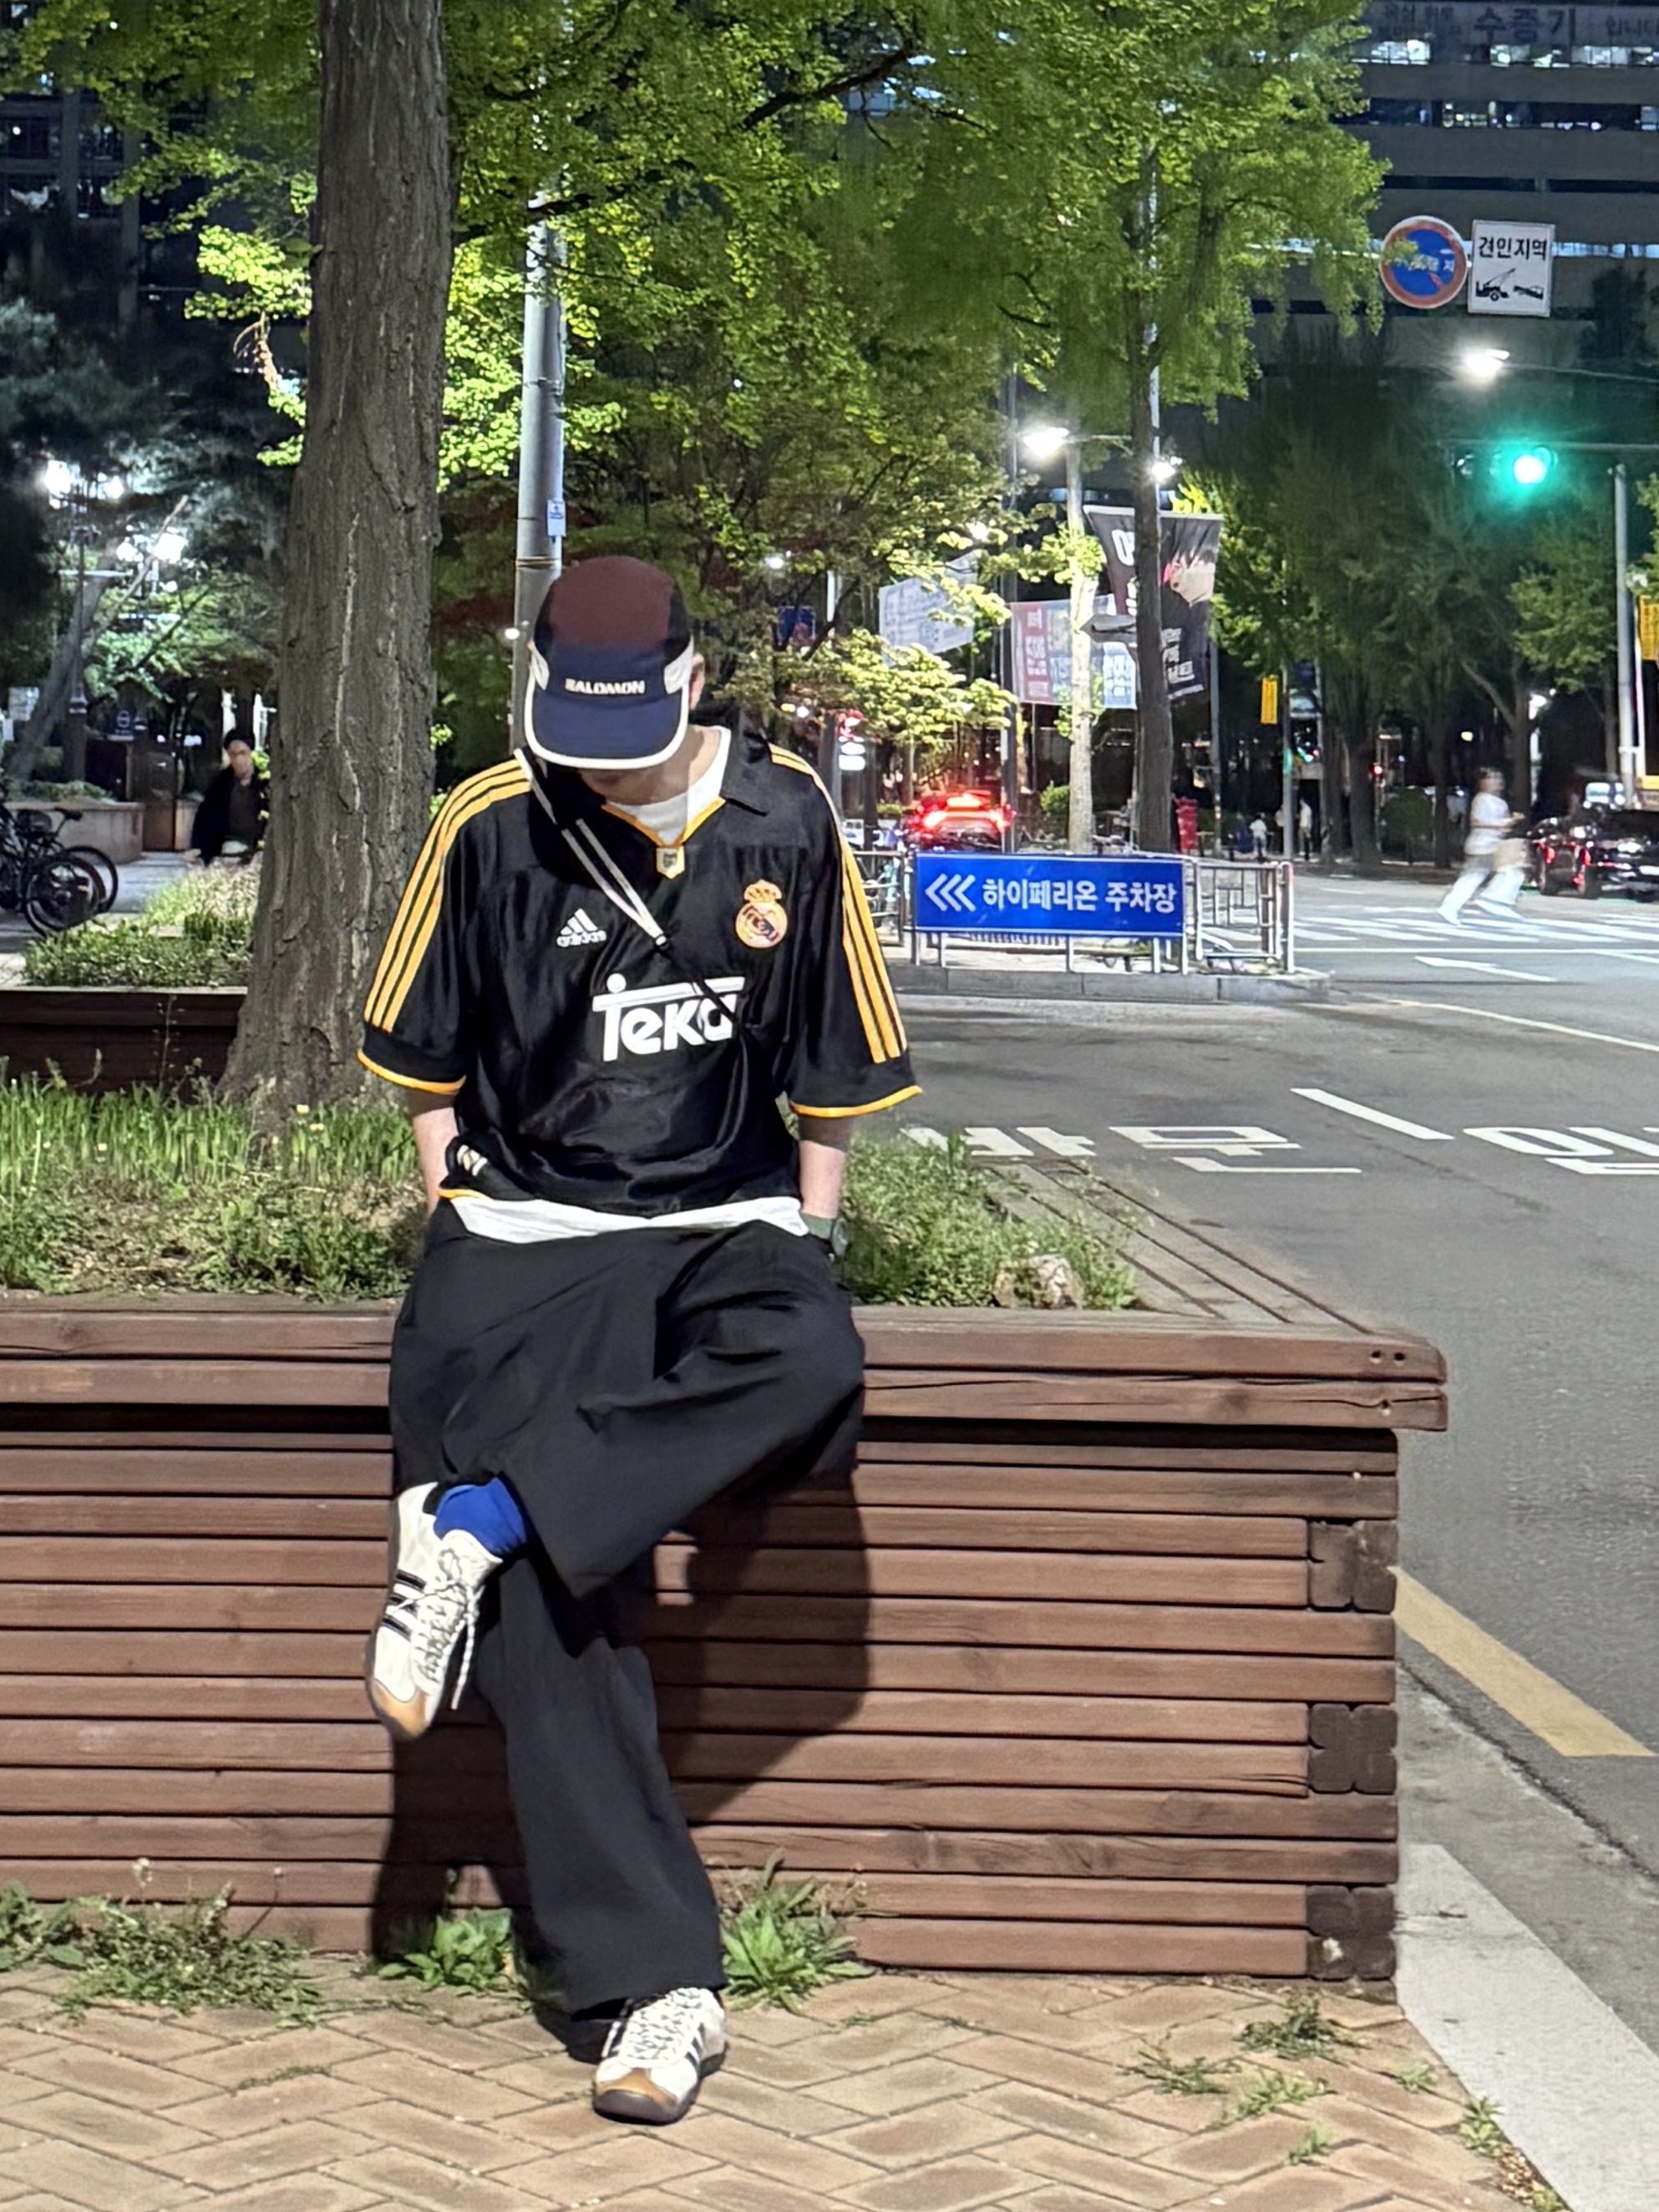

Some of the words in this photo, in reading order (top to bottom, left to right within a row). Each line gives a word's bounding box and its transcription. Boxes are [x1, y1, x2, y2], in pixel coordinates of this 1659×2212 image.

[1479, 236, 1548, 261] 견인지역
[565, 677, 646, 695] SALOMON
[982, 879, 1098, 912] 하이페리온
[1105, 881, 1177, 914] 주차장
[556, 930, 607, 948] adidas
